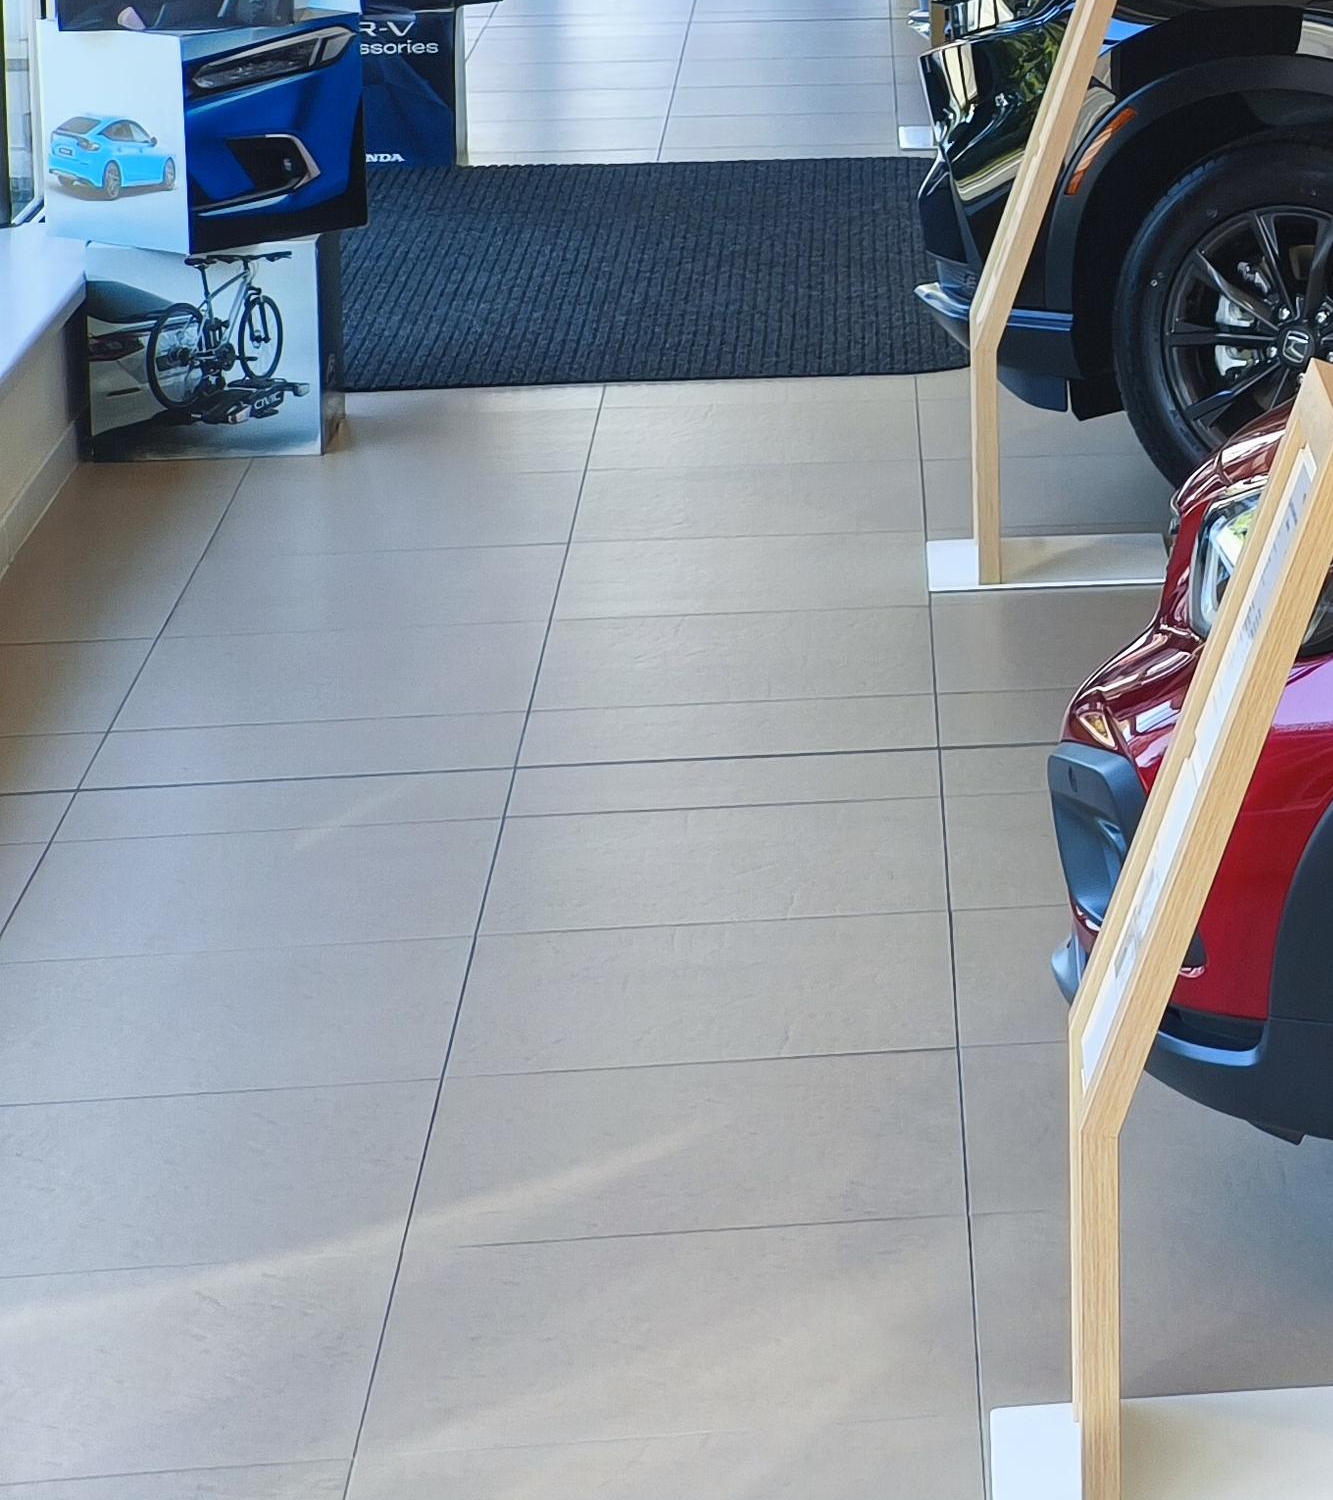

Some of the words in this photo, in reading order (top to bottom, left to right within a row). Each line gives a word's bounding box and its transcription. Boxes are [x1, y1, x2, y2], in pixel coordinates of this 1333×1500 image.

[359, 21, 415, 37] R-V
[360, 39, 439, 55] ssories
[365, 153, 407, 163] NDA
